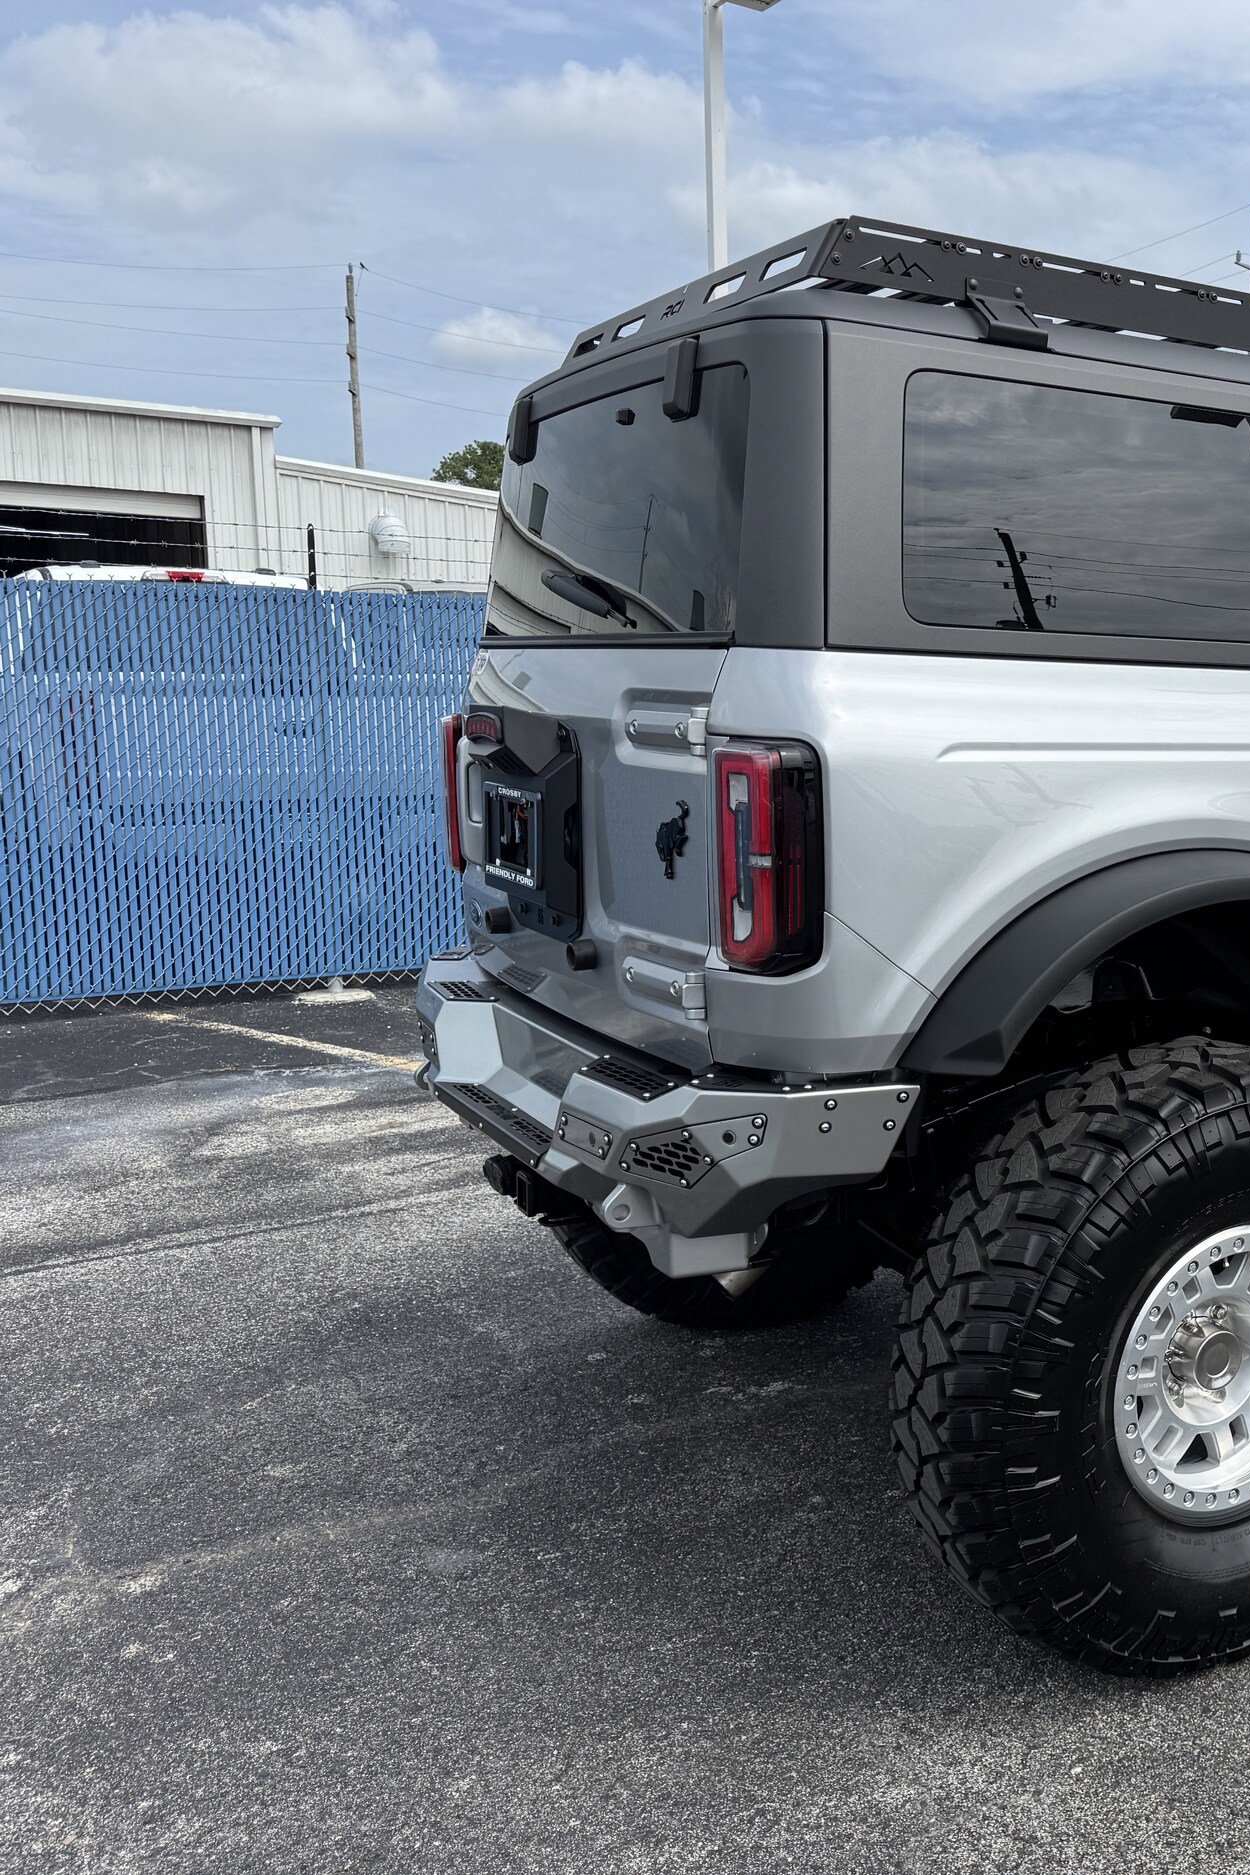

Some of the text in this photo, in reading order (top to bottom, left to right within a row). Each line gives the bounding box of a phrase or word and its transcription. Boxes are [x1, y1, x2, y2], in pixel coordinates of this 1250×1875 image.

[660, 299, 685, 320] RCI
[498, 787, 521, 798] CROSBY
[485, 865, 534, 887] FRIENDLY FORD
